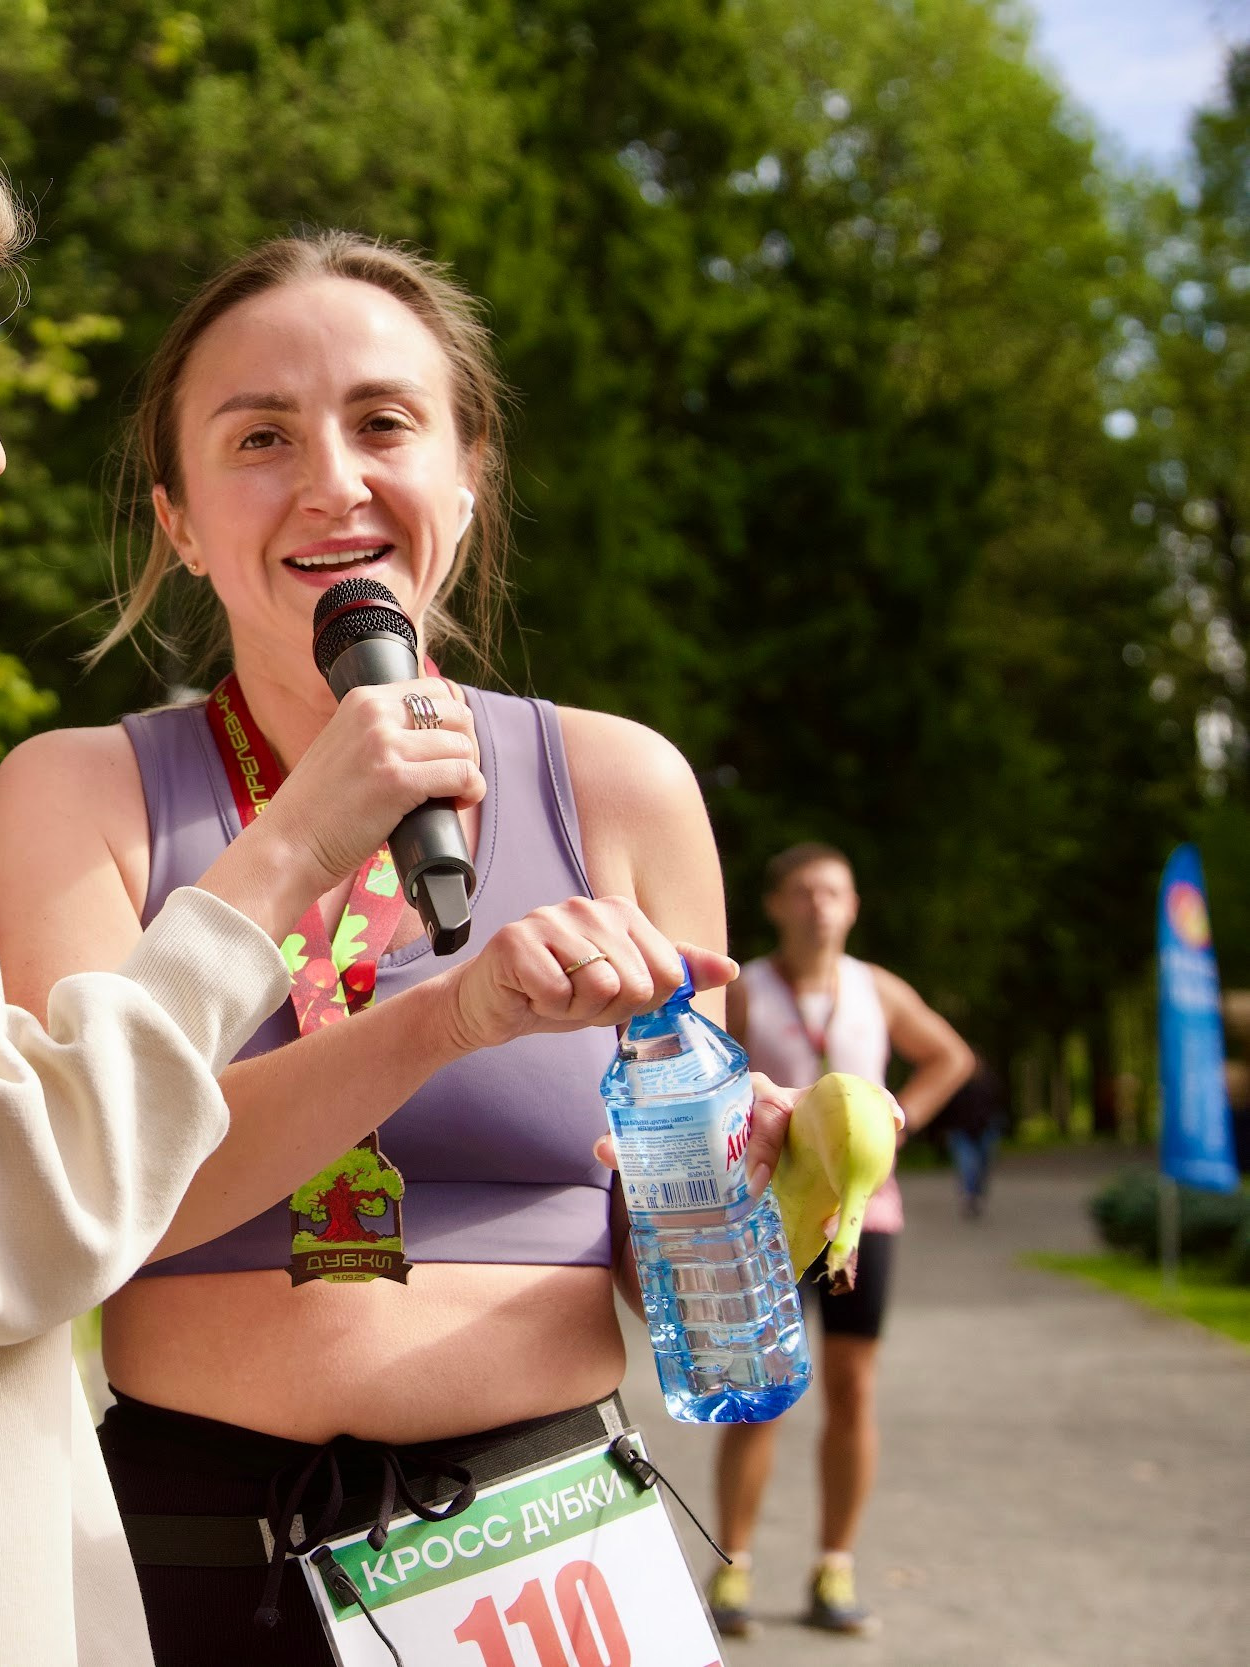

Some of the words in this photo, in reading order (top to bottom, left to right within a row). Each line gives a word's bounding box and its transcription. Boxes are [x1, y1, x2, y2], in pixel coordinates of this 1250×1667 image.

[306, 1253, 392, 1271] ДУБКИ
[361, 1514, 512, 1593] КРОСС
[521, 1468, 627, 1543] ДУБКИ
[454, 1559, 632, 1667] 110
